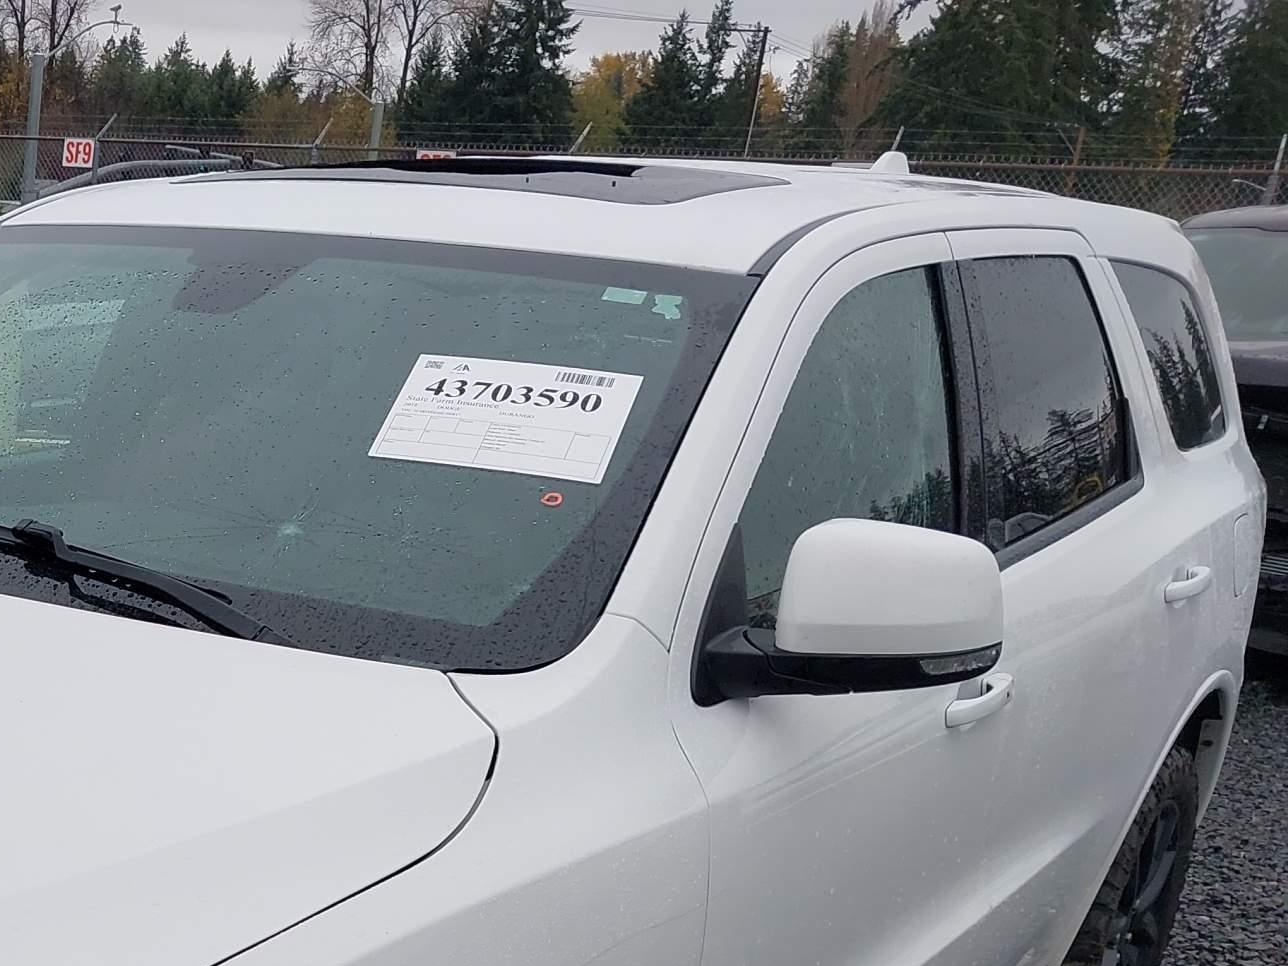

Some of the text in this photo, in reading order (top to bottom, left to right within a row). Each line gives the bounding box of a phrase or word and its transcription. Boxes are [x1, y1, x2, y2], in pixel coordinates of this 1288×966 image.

[66, 141, 92, 164] SF9
[406, 394, 500, 409] State Farm Insurance
[425, 377, 602, 413] 43703590
